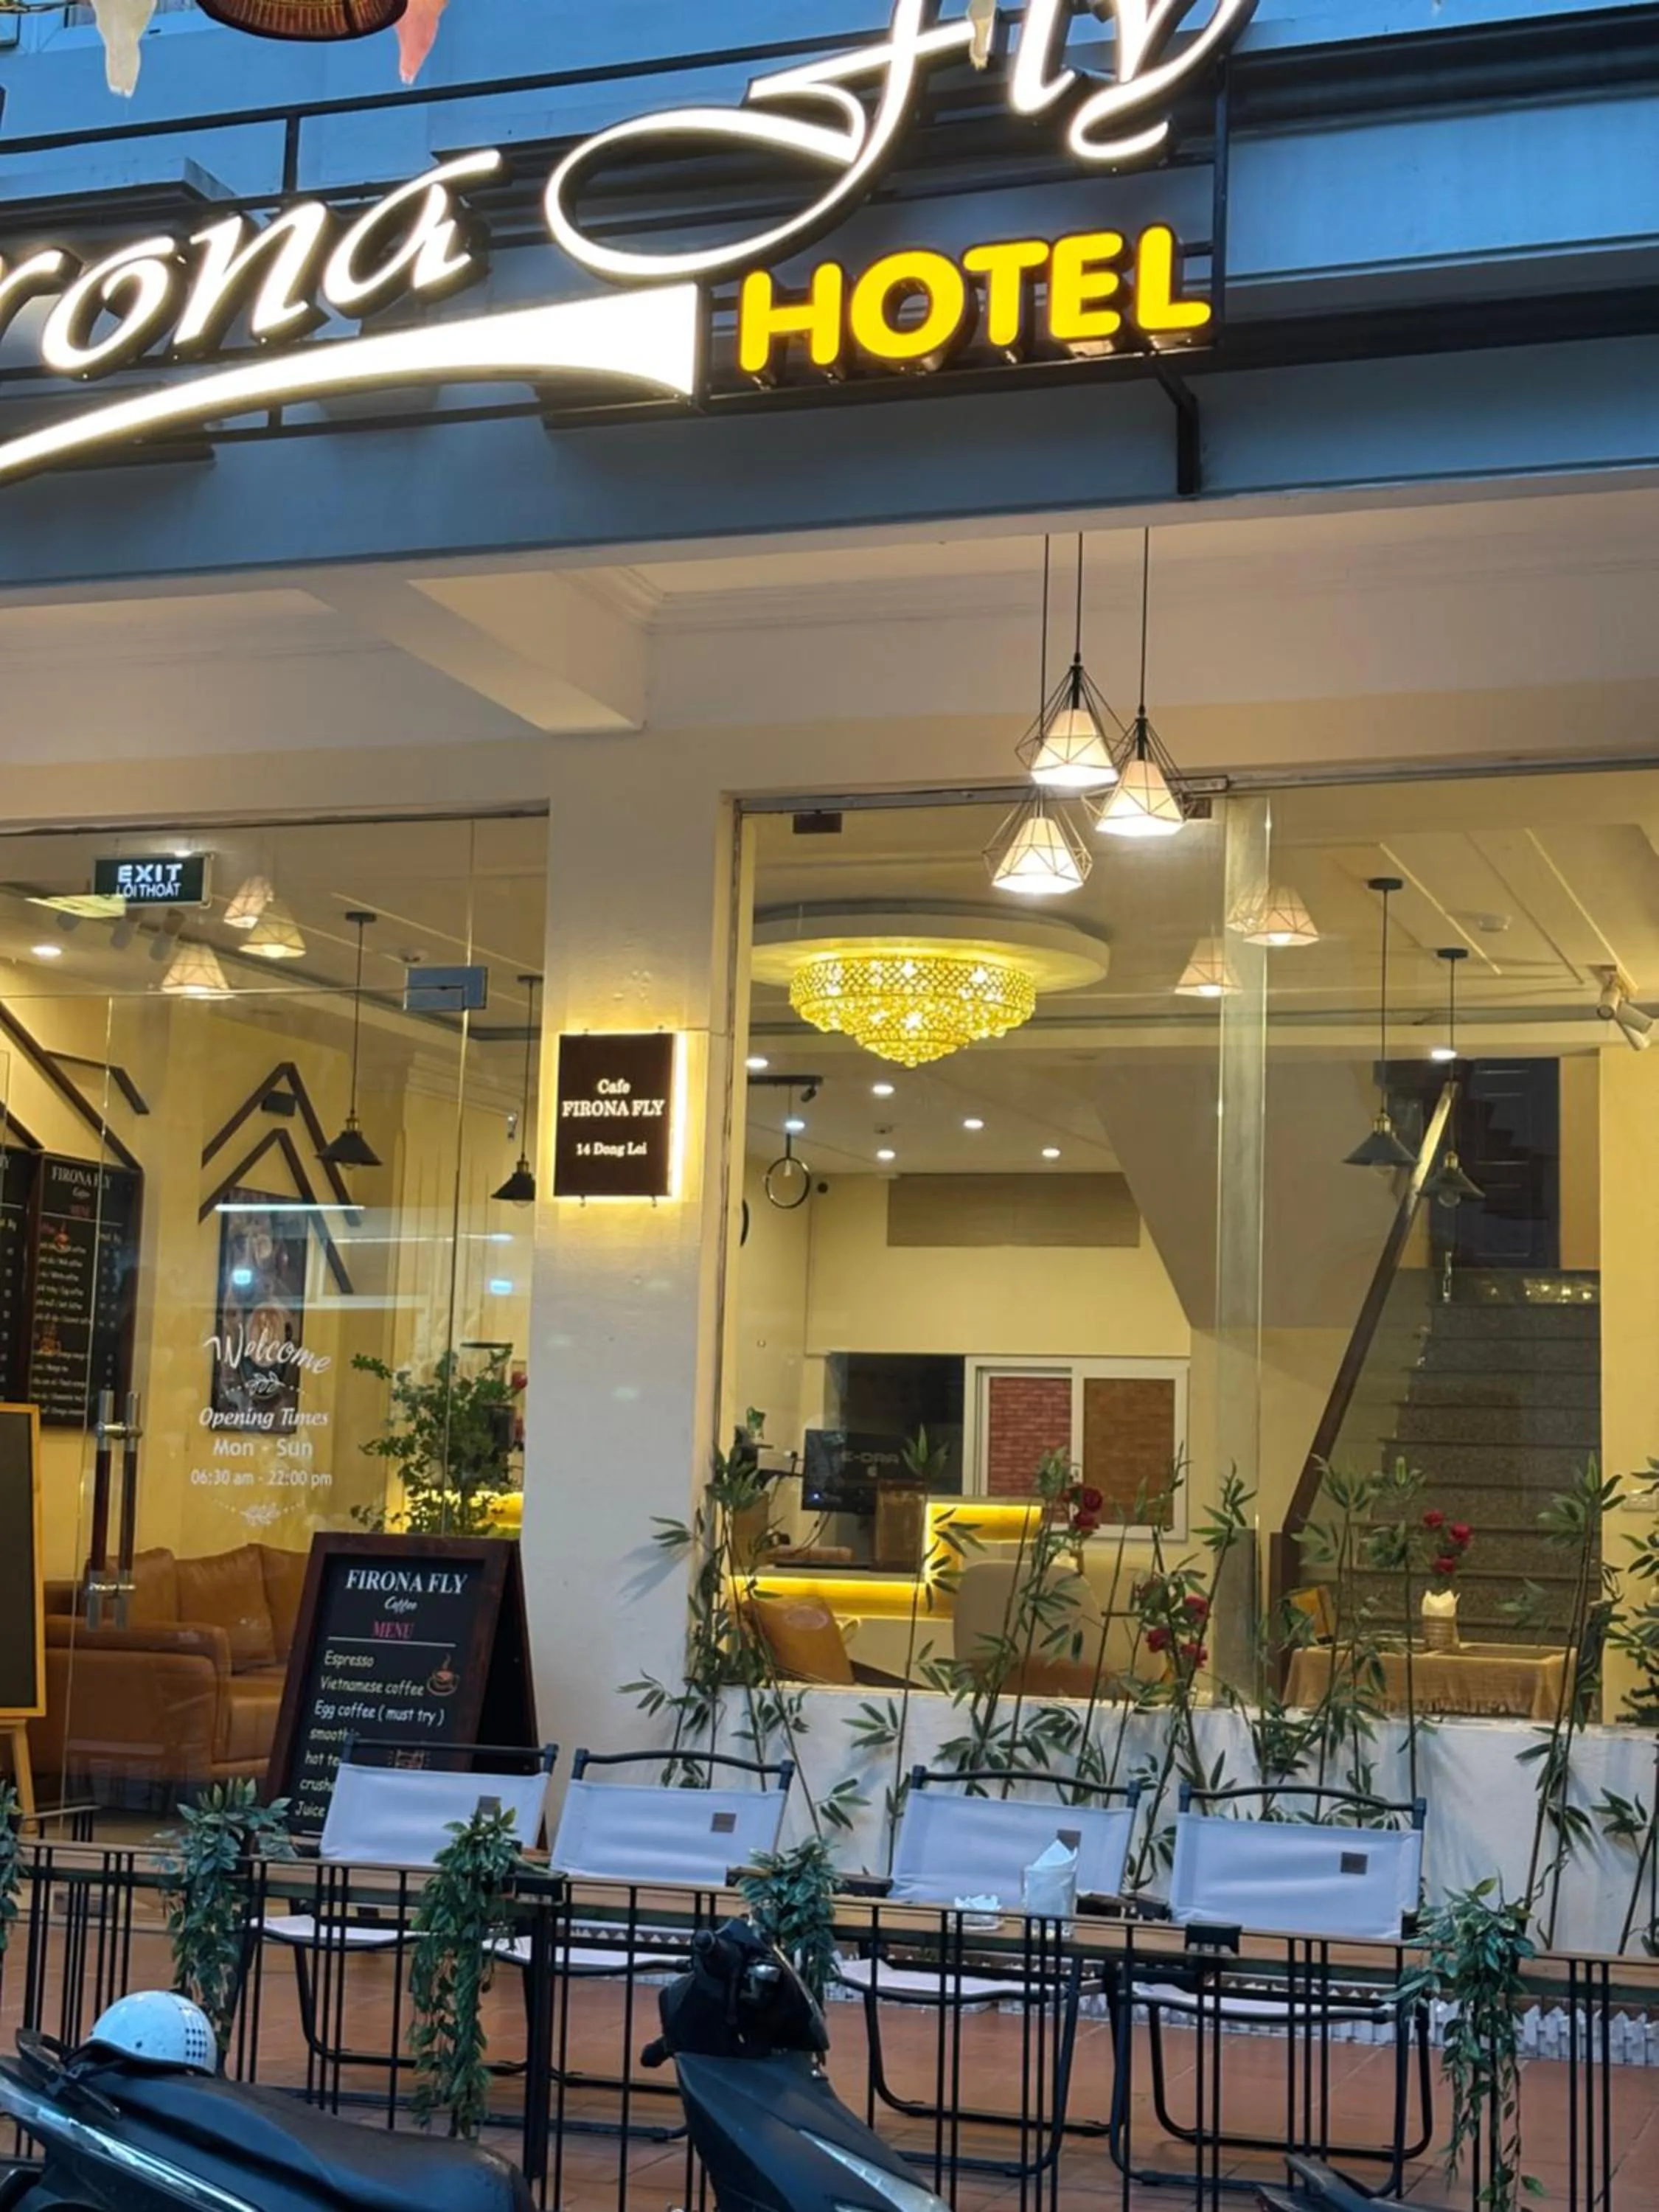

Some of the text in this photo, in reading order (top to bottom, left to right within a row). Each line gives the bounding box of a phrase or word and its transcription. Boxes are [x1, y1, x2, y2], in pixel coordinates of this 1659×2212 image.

[738, 224, 1213, 375] HOTEL
[117, 863, 183, 883] EXIT
[597, 1078, 631, 1094] Cafe
[562, 1099, 665, 1117] FIRONA FLY
[576, 1143, 591, 1155] 14
[593, 1141, 625, 1157] Dong
[202, 1323, 331, 1374] Welcome
[199, 1406, 329, 1429] Opening Times
[213, 1438, 254, 1456] Mon
[276, 1438, 313, 1456] Sun
[190, 1469, 230, 1486] 06:30
[232, 1472, 254, 1485] am
[268, 1470, 308, 1486] 22:00
[310, 1472, 333, 1489] pm
[345, 1568, 468, 1595] FIRONA FLY
[372, 1621, 414, 1639] MENU
[324, 1649, 375, 1669] Espresso
[320, 1675, 425, 1696] Vietnamese coffee
[314, 1699, 335, 1719] Egg
[338, 1701, 375, 1719] coffee
[304, 1750, 325, 1765] hot
[294, 1799, 327, 1818] Juice
